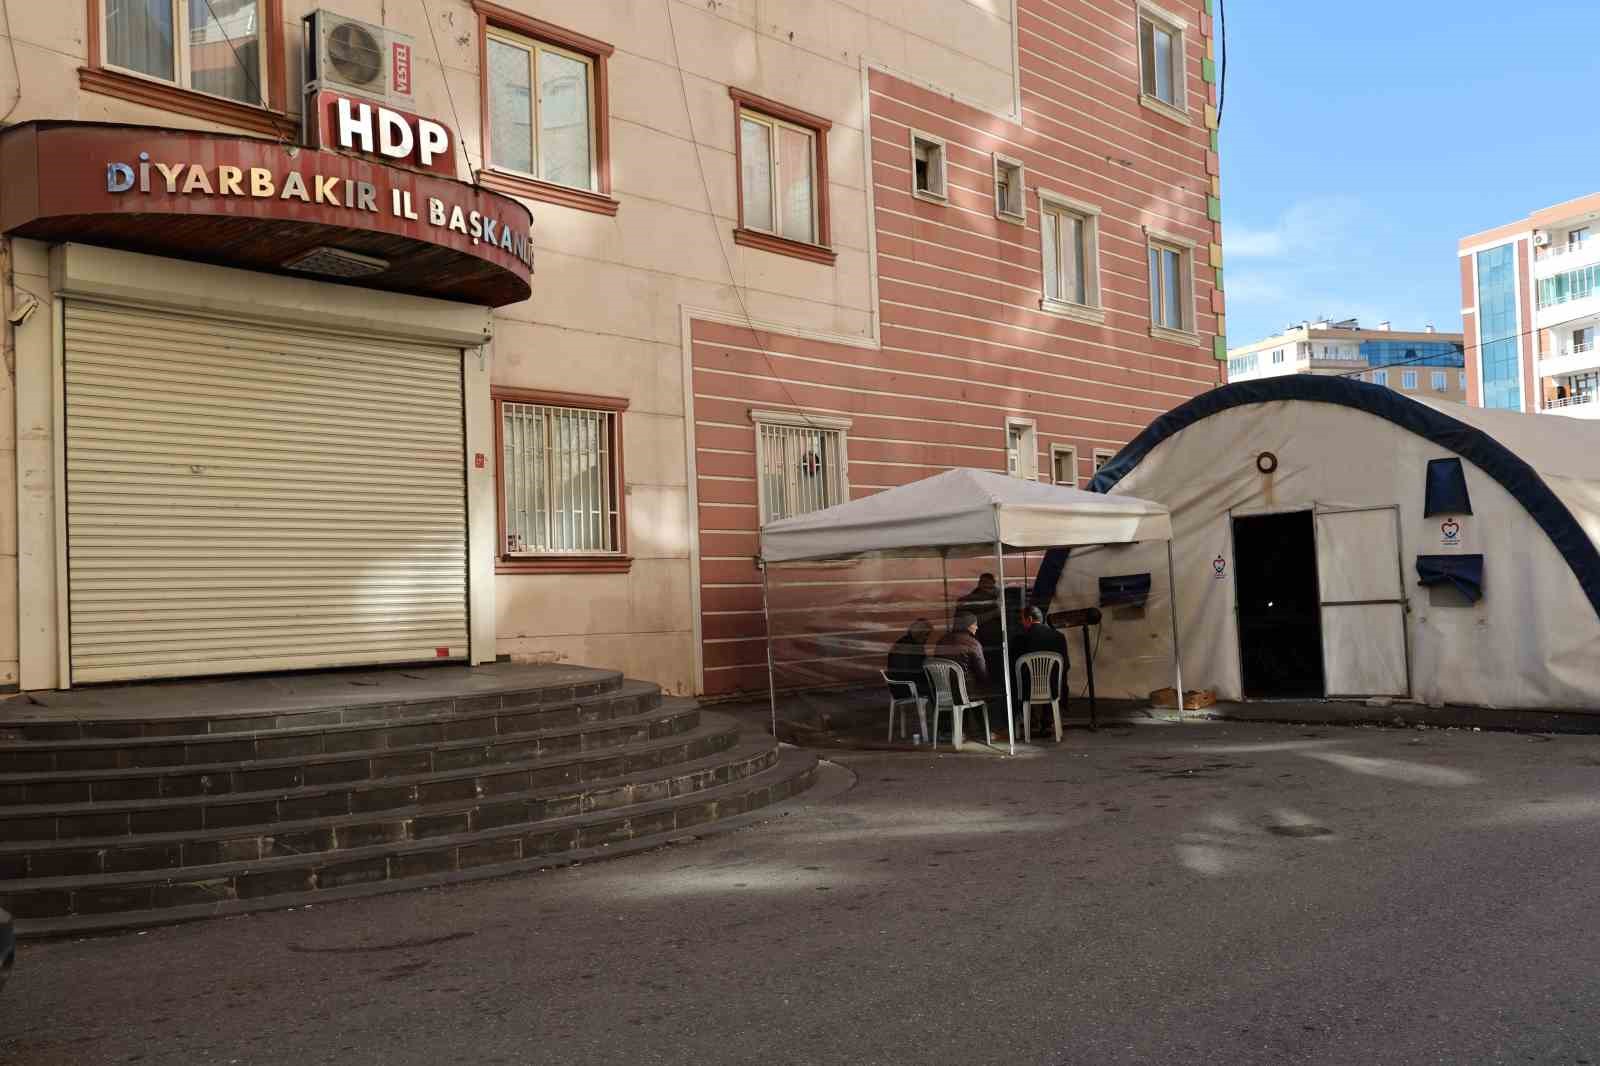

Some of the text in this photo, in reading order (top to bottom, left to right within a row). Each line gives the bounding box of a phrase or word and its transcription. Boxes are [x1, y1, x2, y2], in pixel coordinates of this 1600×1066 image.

[397, 46, 408, 93] VESTEL
[337, 97, 449, 166] HDP
[107, 151, 378, 212] DİYARBAKIR
